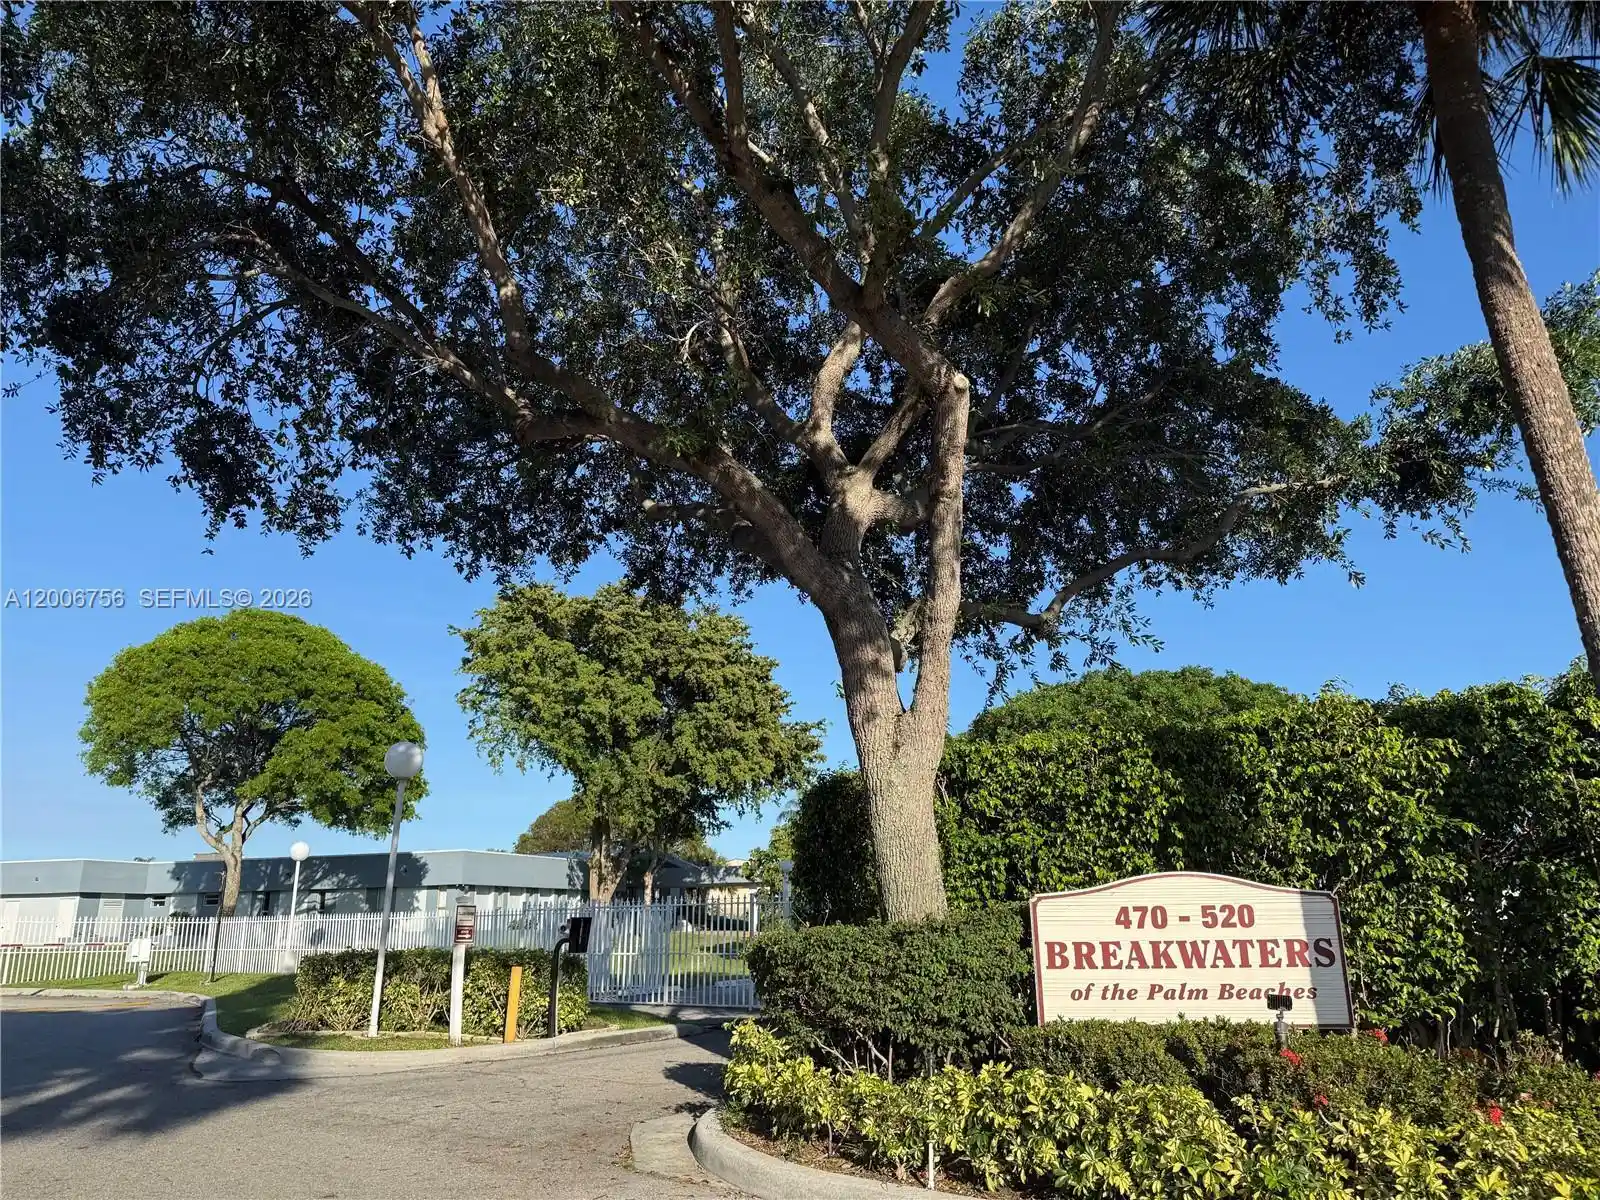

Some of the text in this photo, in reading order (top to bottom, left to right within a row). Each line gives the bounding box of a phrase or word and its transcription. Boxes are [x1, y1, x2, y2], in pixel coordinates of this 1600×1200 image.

[1115, 906, 1167, 929] 470
[1201, 904, 1255, 928] 520
[1045, 938, 1336, 970] BREAKWATERS
[1070, 982, 1318, 1001] of the Palm Beaches
